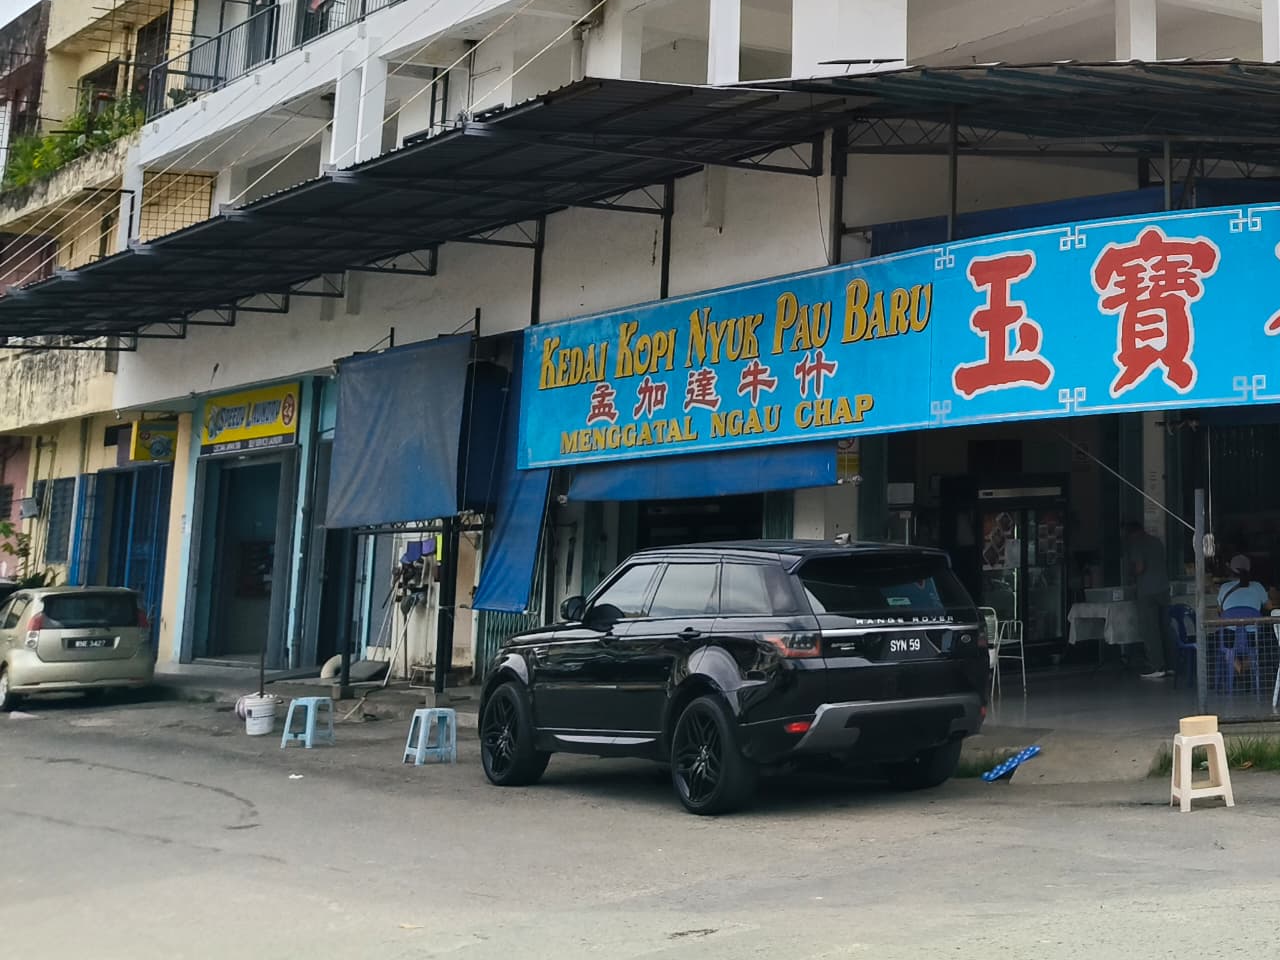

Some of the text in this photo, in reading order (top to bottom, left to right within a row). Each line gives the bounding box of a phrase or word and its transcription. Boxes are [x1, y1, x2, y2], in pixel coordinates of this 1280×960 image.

[538, 278, 933, 390] KEDAI KOPI NYUK PAU BARU
[586, 348, 838, 426] 孟加達牛什
[560, 394, 874, 454] MENGGATAL NGAU CHAP
[855, 615, 955, 625] RANGE ROVER
[890, 639, 921, 652] SYN 59
